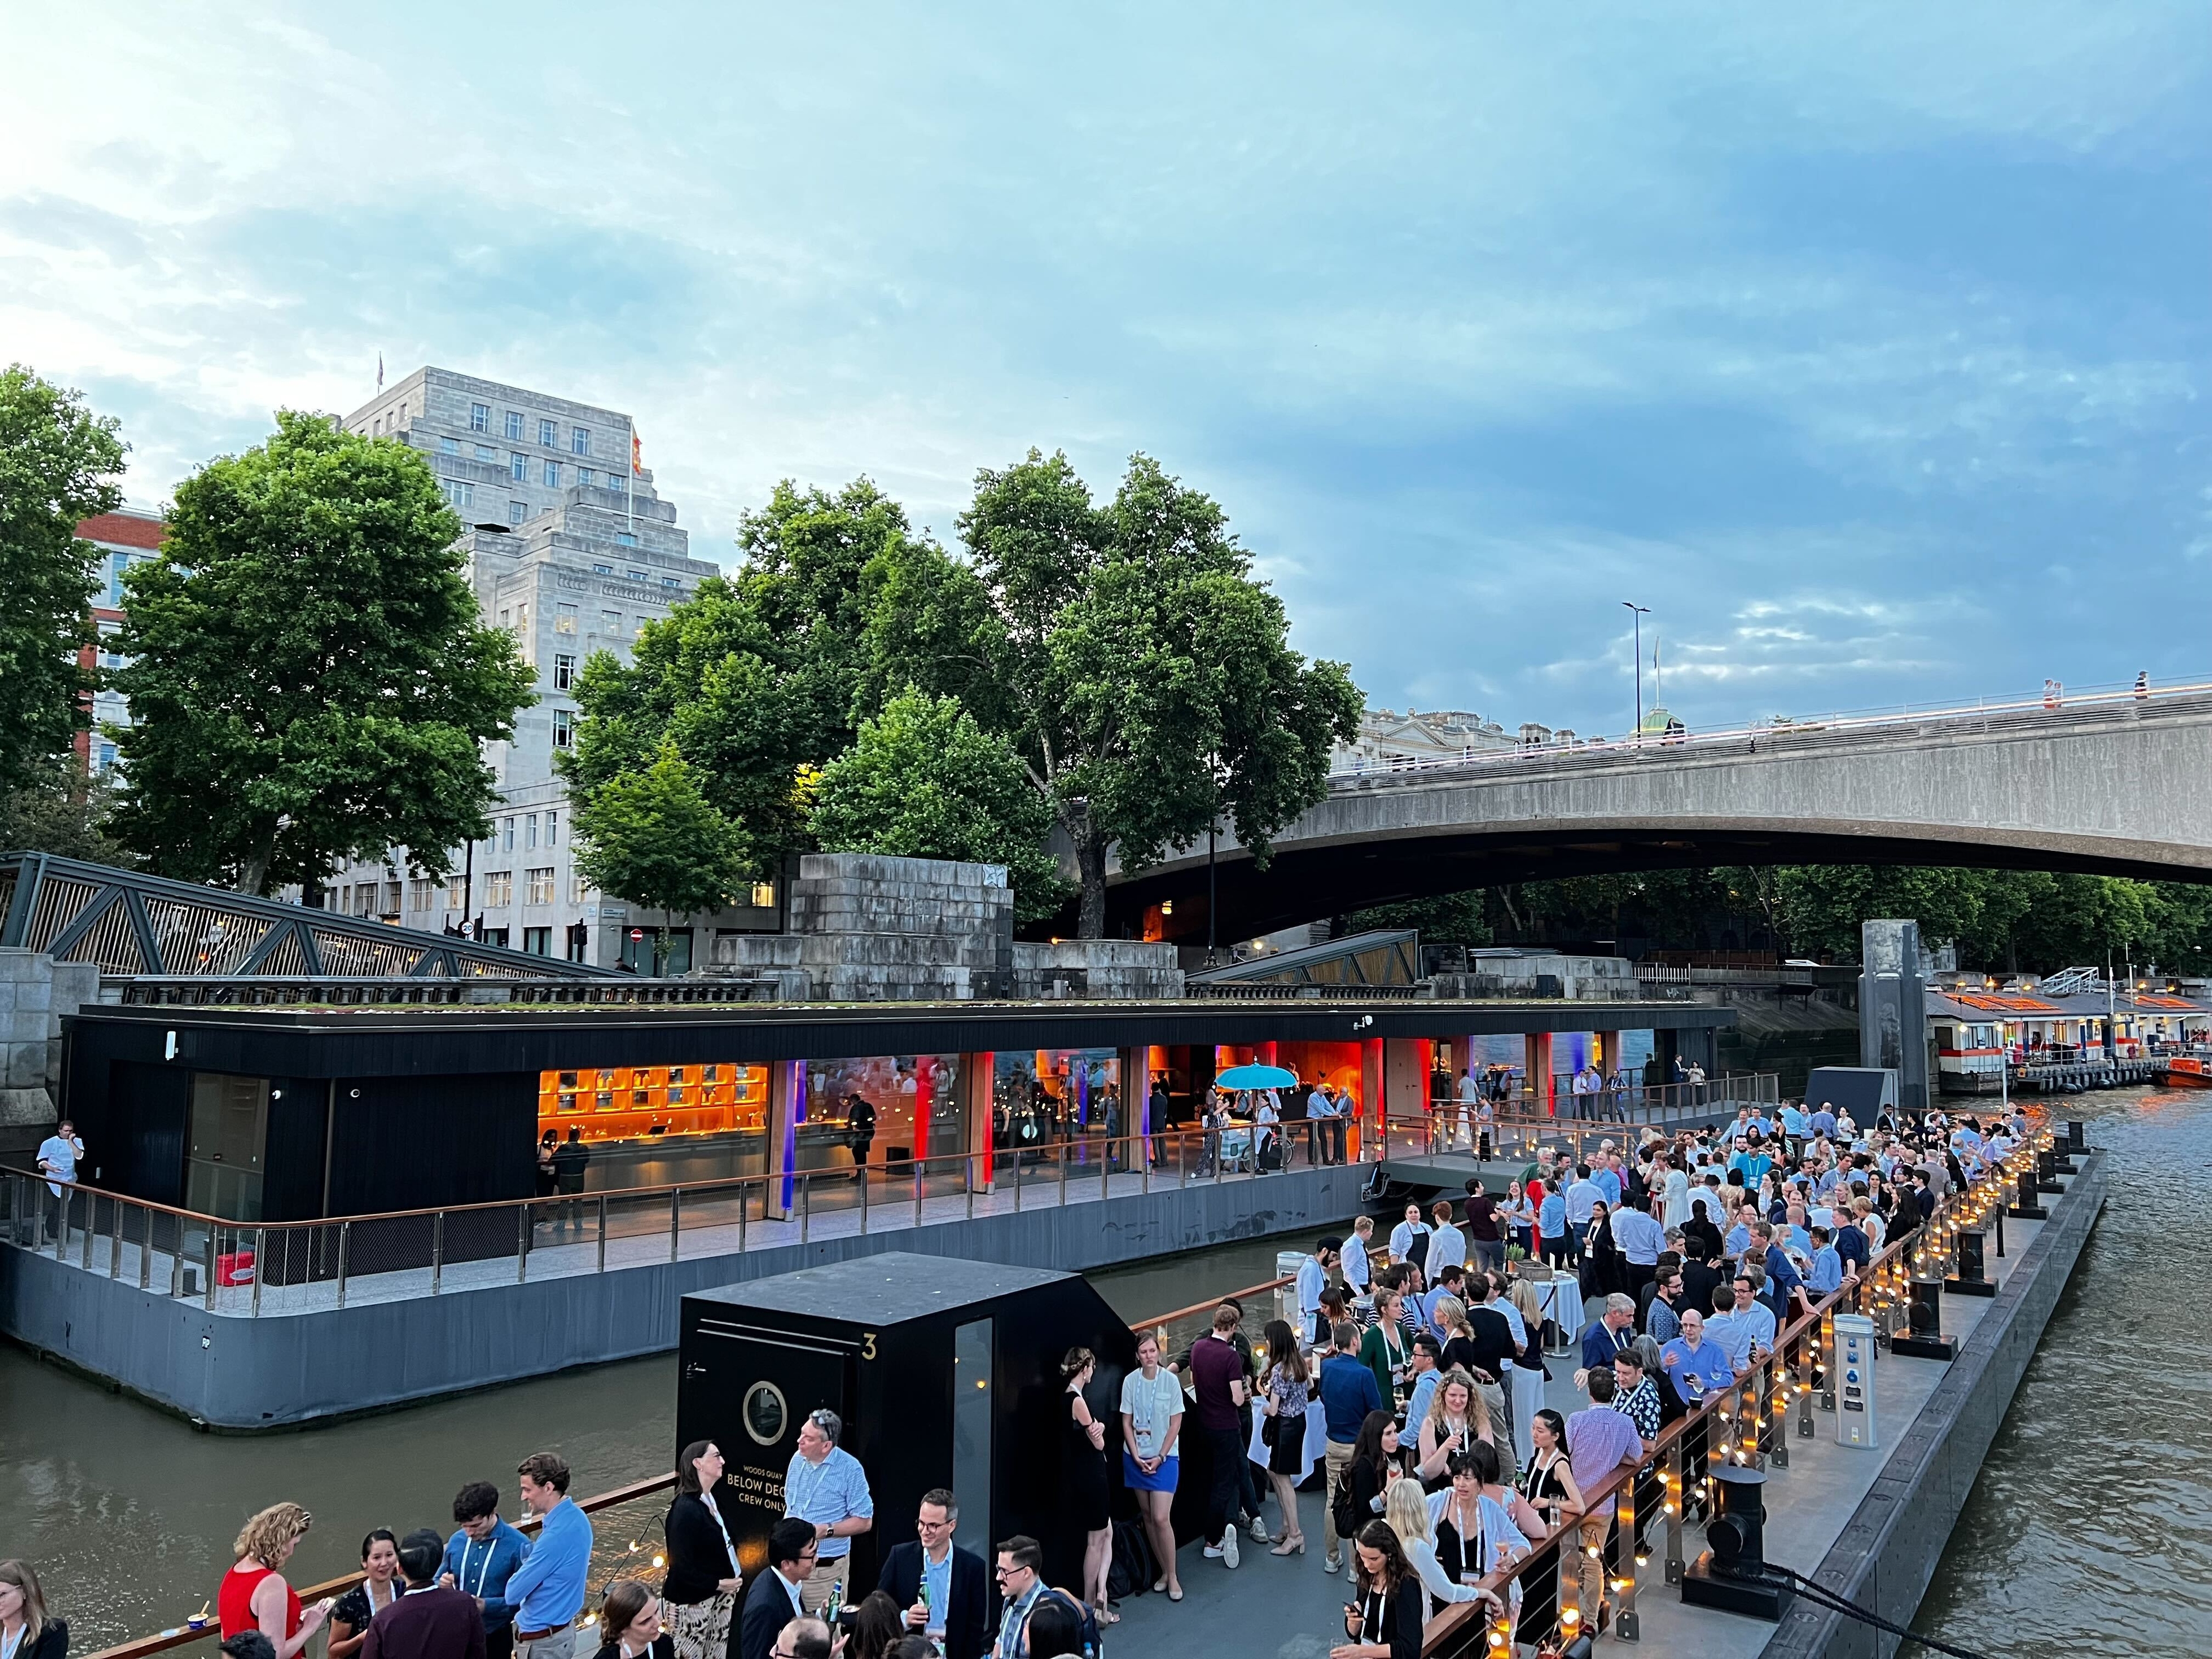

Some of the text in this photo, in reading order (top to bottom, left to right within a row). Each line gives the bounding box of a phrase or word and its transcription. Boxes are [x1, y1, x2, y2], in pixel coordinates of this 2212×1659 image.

[862, 1332, 877, 1360] 3
[743, 1465, 783, 1480] WOODS QUAY
[728, 1474, 785, 1498] BELOW DEC
[738, 1493, 786, 1512] CREW ONLY
